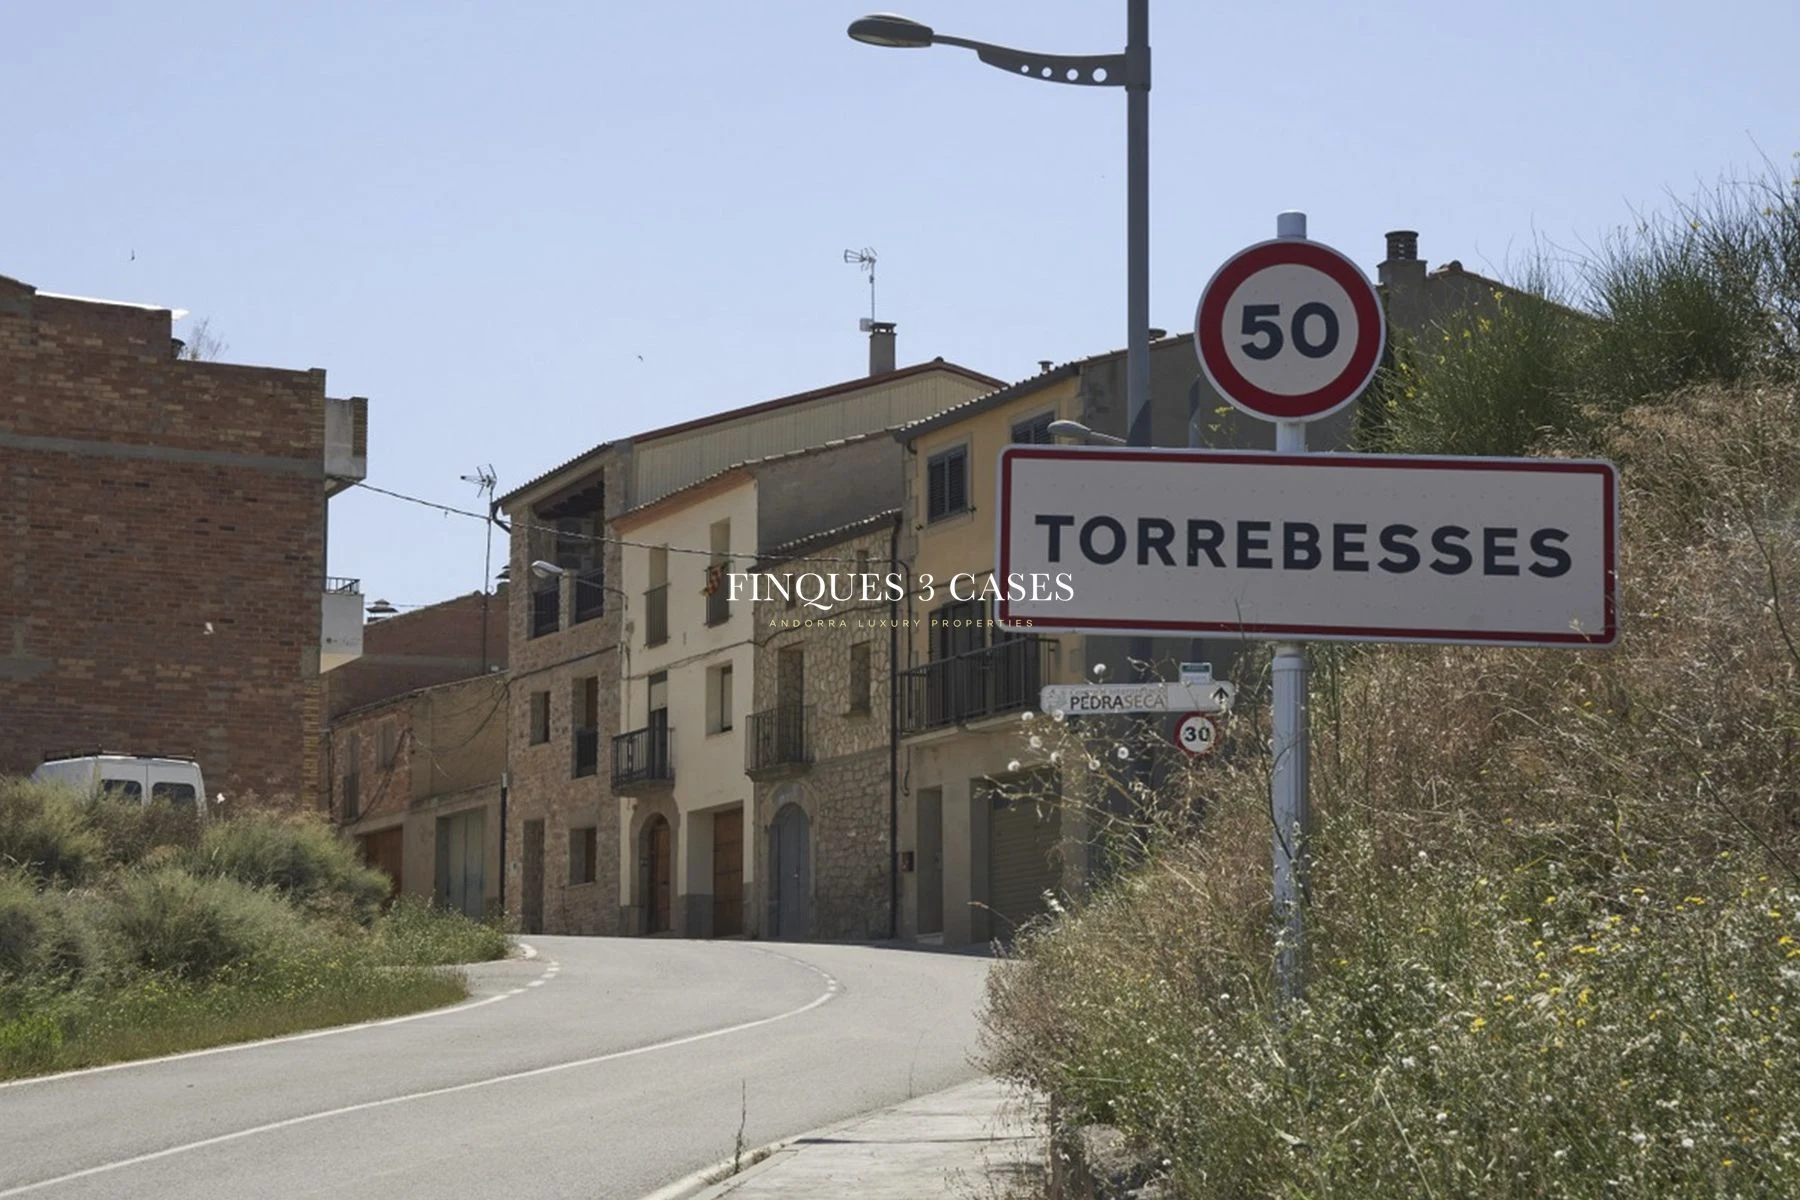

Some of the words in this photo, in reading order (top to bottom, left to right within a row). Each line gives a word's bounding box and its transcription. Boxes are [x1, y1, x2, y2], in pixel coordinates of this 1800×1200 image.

[1240, 301, 1340, 361] 50
[1034, 513, 1572, 579] TORREBESSES
[1184, 726, 1211, 743] 30
